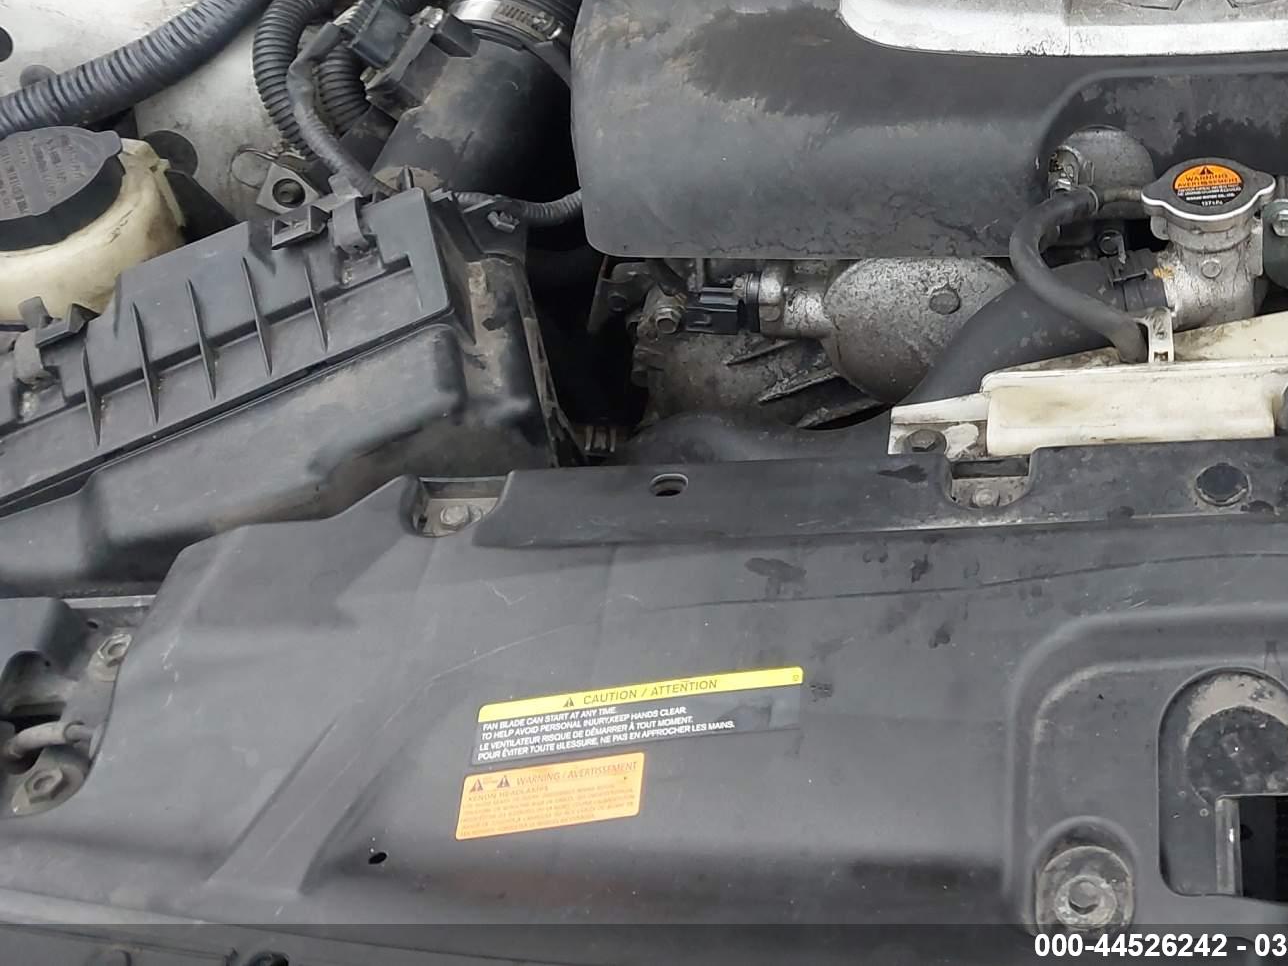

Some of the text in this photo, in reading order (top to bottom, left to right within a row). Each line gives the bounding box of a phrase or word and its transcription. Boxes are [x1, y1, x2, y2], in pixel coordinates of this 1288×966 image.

[583, 689, 637, 705] CAUTION
[650, 679, 718, 697] ATTENTION
[479, 742, 489, 751] LE
[491, 736, 541, 750] VENTILATEUR
[541, 732, 572, 743] RISQUE
[572, 730, 584, 738] DE
[585, 723, 628, 737] DÉMARRER
[636, 720, 657, 730] TOUT
[658, 715, 694, 727] MOMENT.
[481, 732, 492, 741] TO
[494, 729, 515, 739] HELP
[515, 726, 539, 736] AVOID
[540, 721, 582, 733] PERSONAL
[631, 709, 659, 720] HANDS
[482, 723, 498, 732] FAN
[500, 720, 526, 730] BLADE
[526, 717, 544, 727] CAN
[545, 715, 568, 724] START
[569, 712, 581, 721] AT
[580, 710, 598, 719] ANY
[477, 751, 502, 761] POUR
[502, 745, 529, 757] ÉVITER
[530, 742, 555, 753] TOUTE
[599, 736, 612, 744] NE
[612, 732, 628, 743] PAS
[629, 730, 642, 740] EN
[642, 724, 691, 739] APPROCHER
[691, 722, 708, 732] LES
[708, 720, 736, 731] MAINS.
[516, 771, 561, 787] WARNING
[567, 761, 638, 780] AVERTISSEMENT
